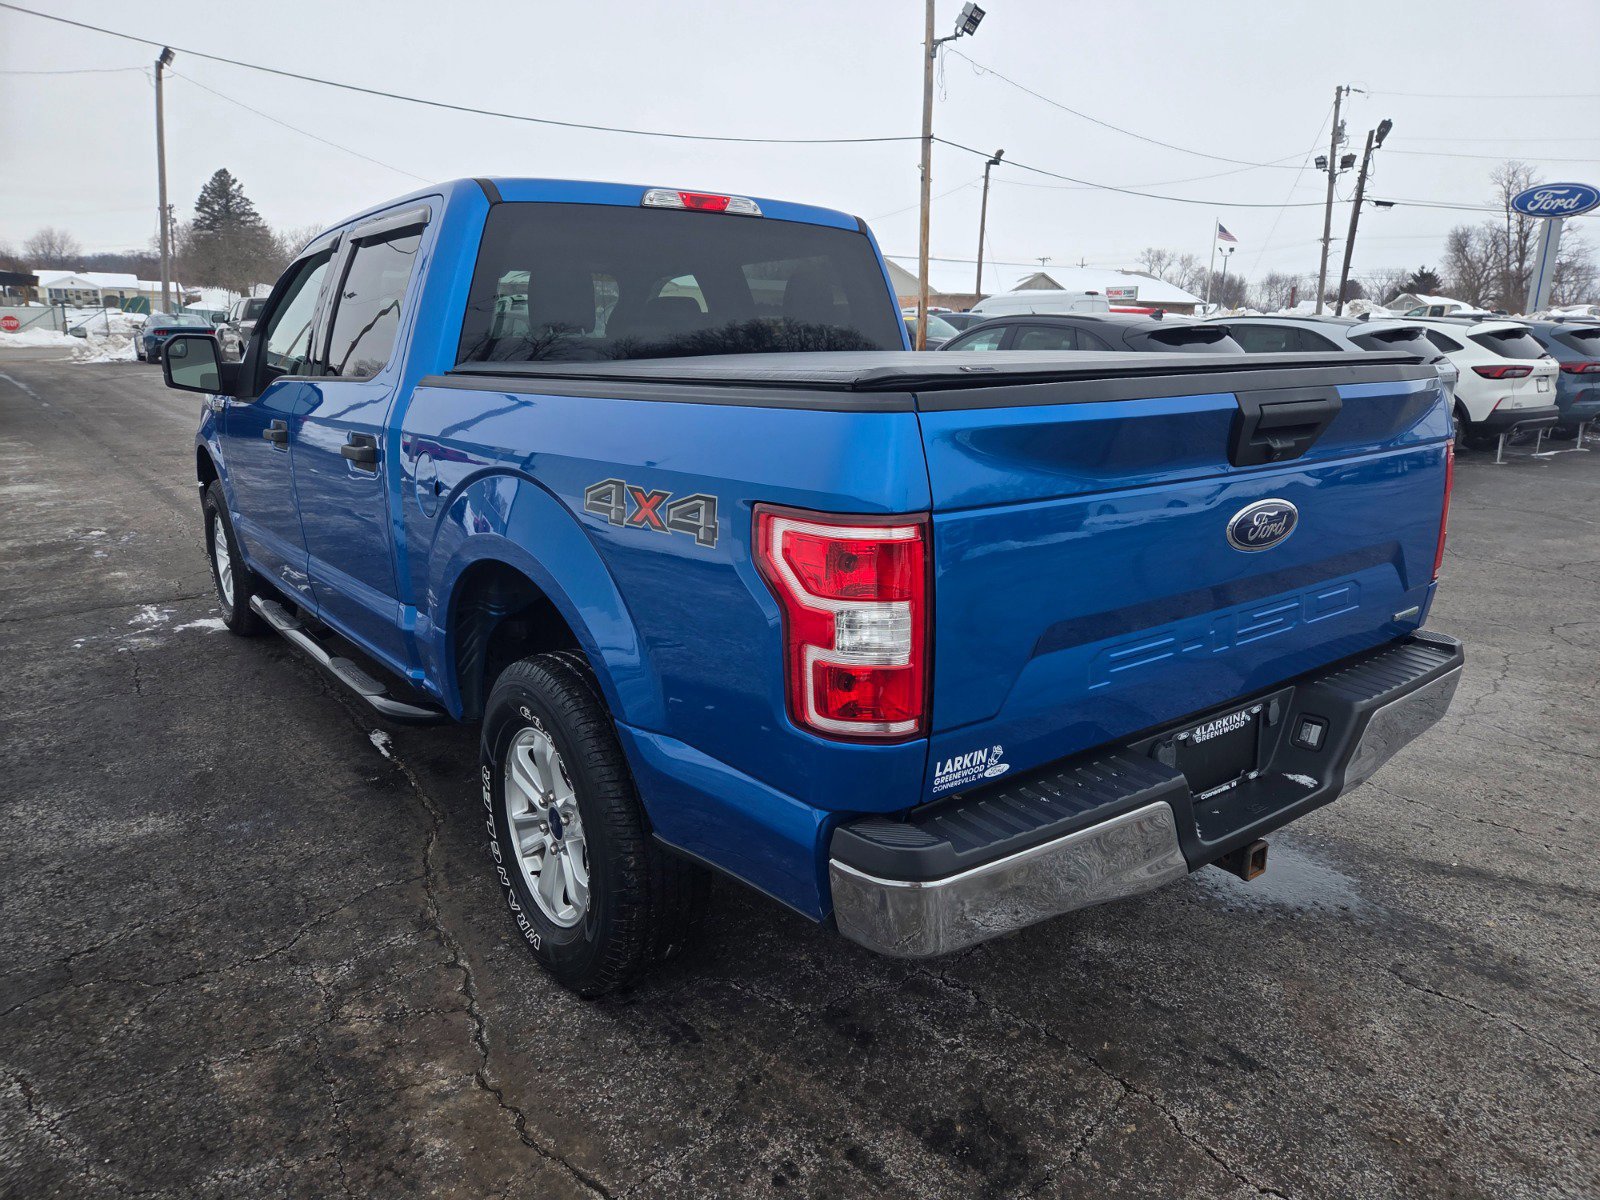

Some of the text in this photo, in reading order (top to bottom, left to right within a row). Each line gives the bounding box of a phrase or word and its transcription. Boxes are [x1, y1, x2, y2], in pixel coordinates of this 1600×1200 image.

[1527, 189, 1582, 211] Ford
[1248, 510, 1287, 541] Ford
[1195, 720, 1245, 743] GREENEWOOD
[1201, 712, 1242, 735] LARKIN
[935, 748, 988, 777] LARKIN
[934, 764, 985, 786] GREENEWOOD
[482, 765, 541, 951] WRANGLER
